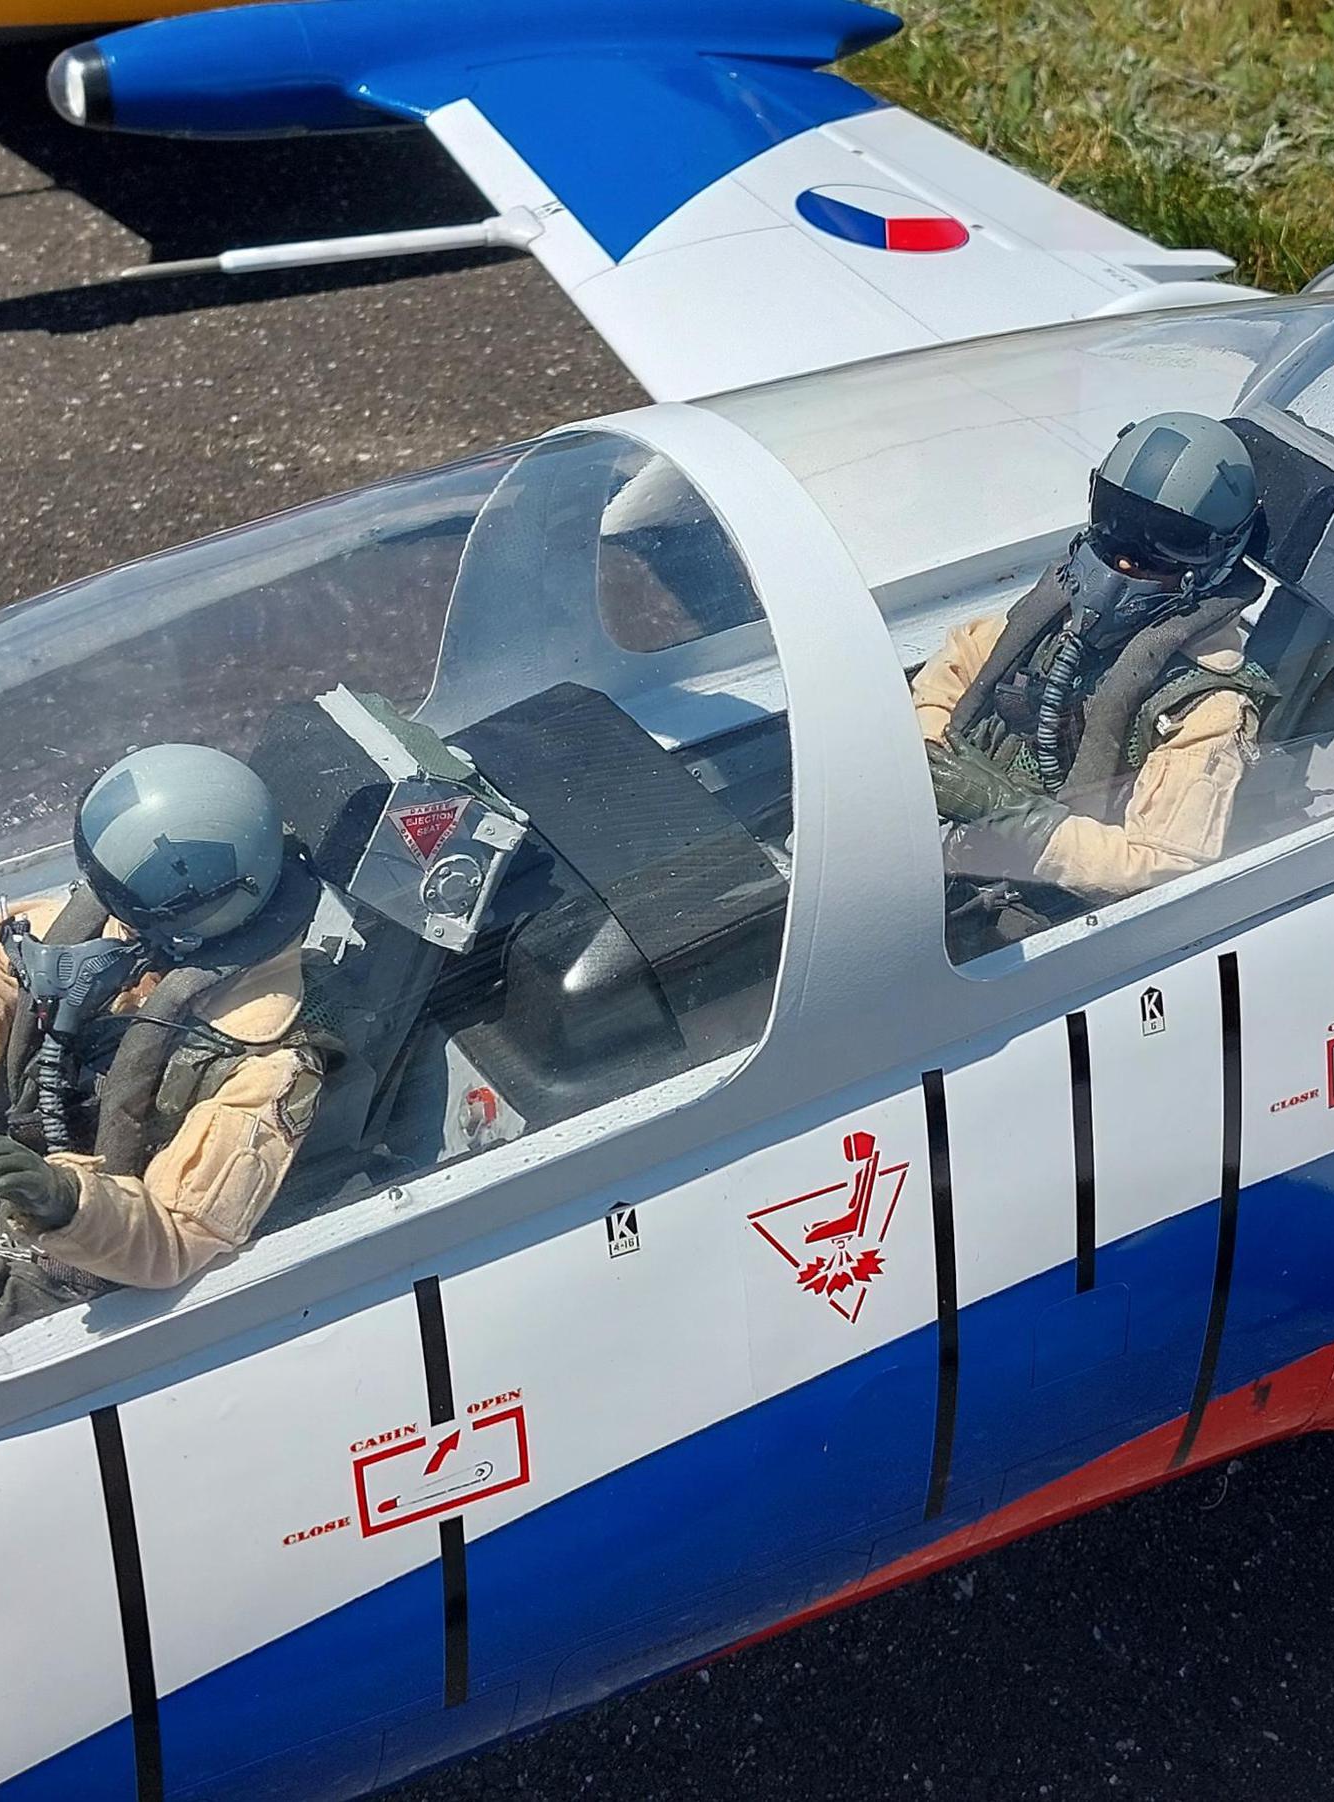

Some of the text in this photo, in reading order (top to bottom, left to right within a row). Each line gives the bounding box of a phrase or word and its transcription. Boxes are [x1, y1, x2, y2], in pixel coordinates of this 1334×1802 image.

[406, 811, 454, 827] EJECTION
[417, 823, 442, 837] SEAT
[1270, 1088, 1320, 1114] CLOSE
[349, 1388, 522, 1454] CABIN OPEN
[282, 1515, 352, 1547] CLOSE
